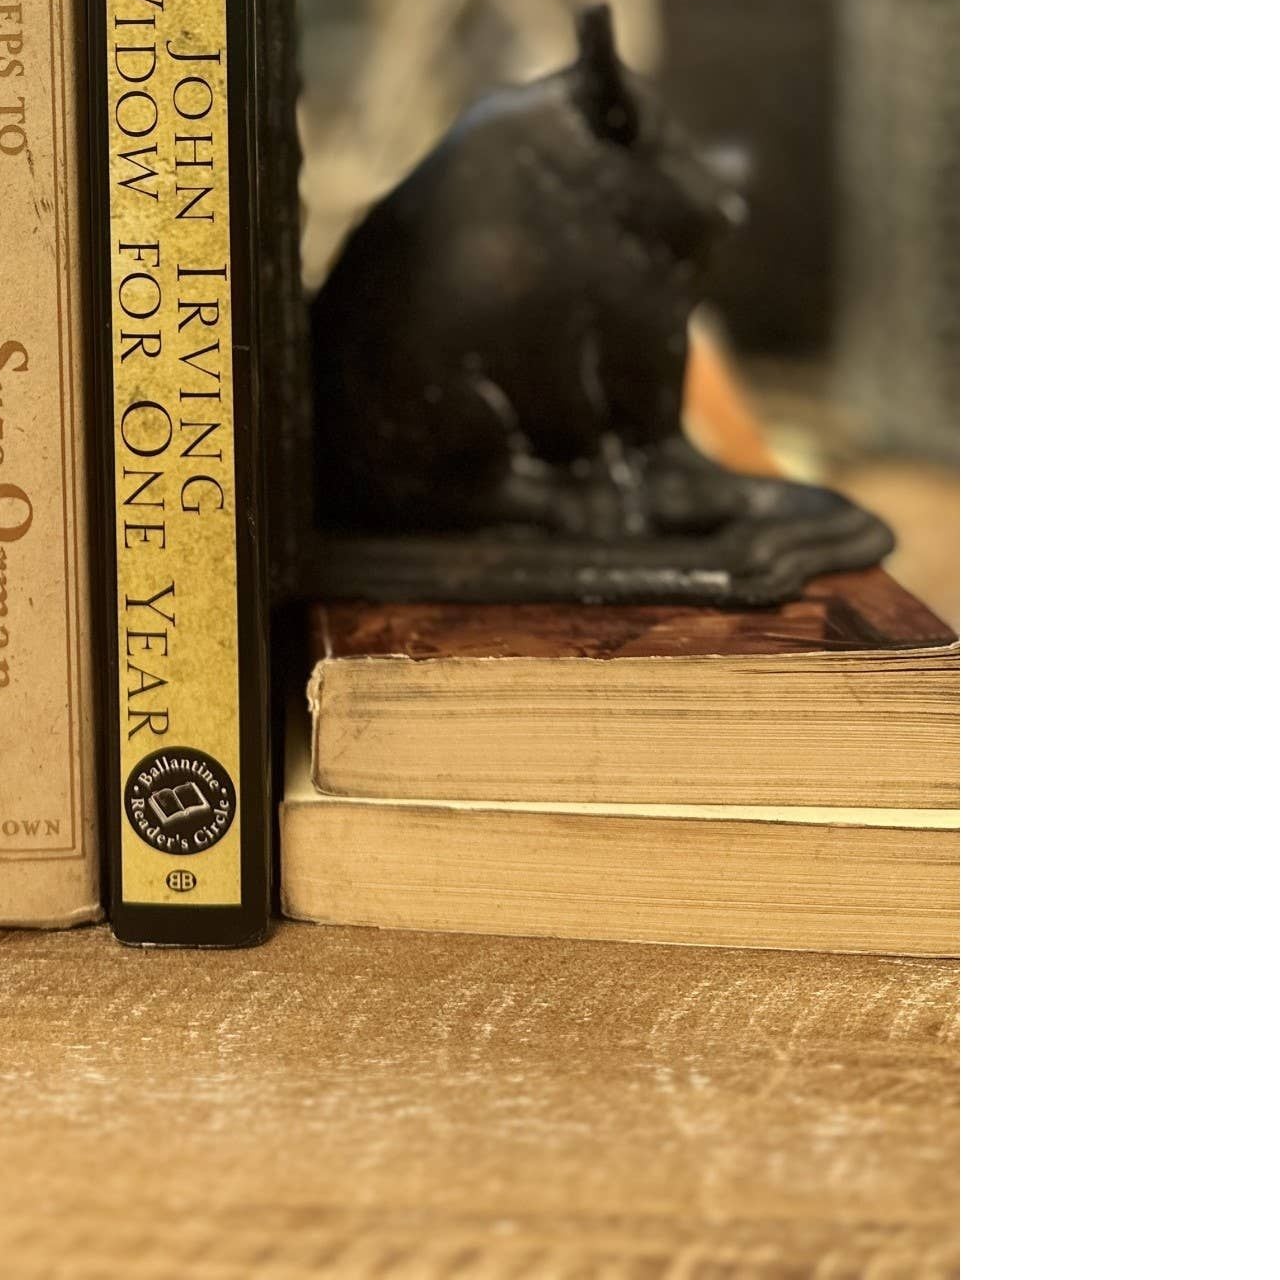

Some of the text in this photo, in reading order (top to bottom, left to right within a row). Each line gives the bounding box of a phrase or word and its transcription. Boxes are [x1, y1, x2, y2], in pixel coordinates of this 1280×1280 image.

[118, 239, 163, 364] FOR
[166, 39, 225, 516] JOHN IRVING
[120, 400, 173, 550] ONE
[125, 580, 176, 741] YEAR
[131, 798, 230, 850] Reader's Circle
[137, 756, 220, 789] Ballantine
